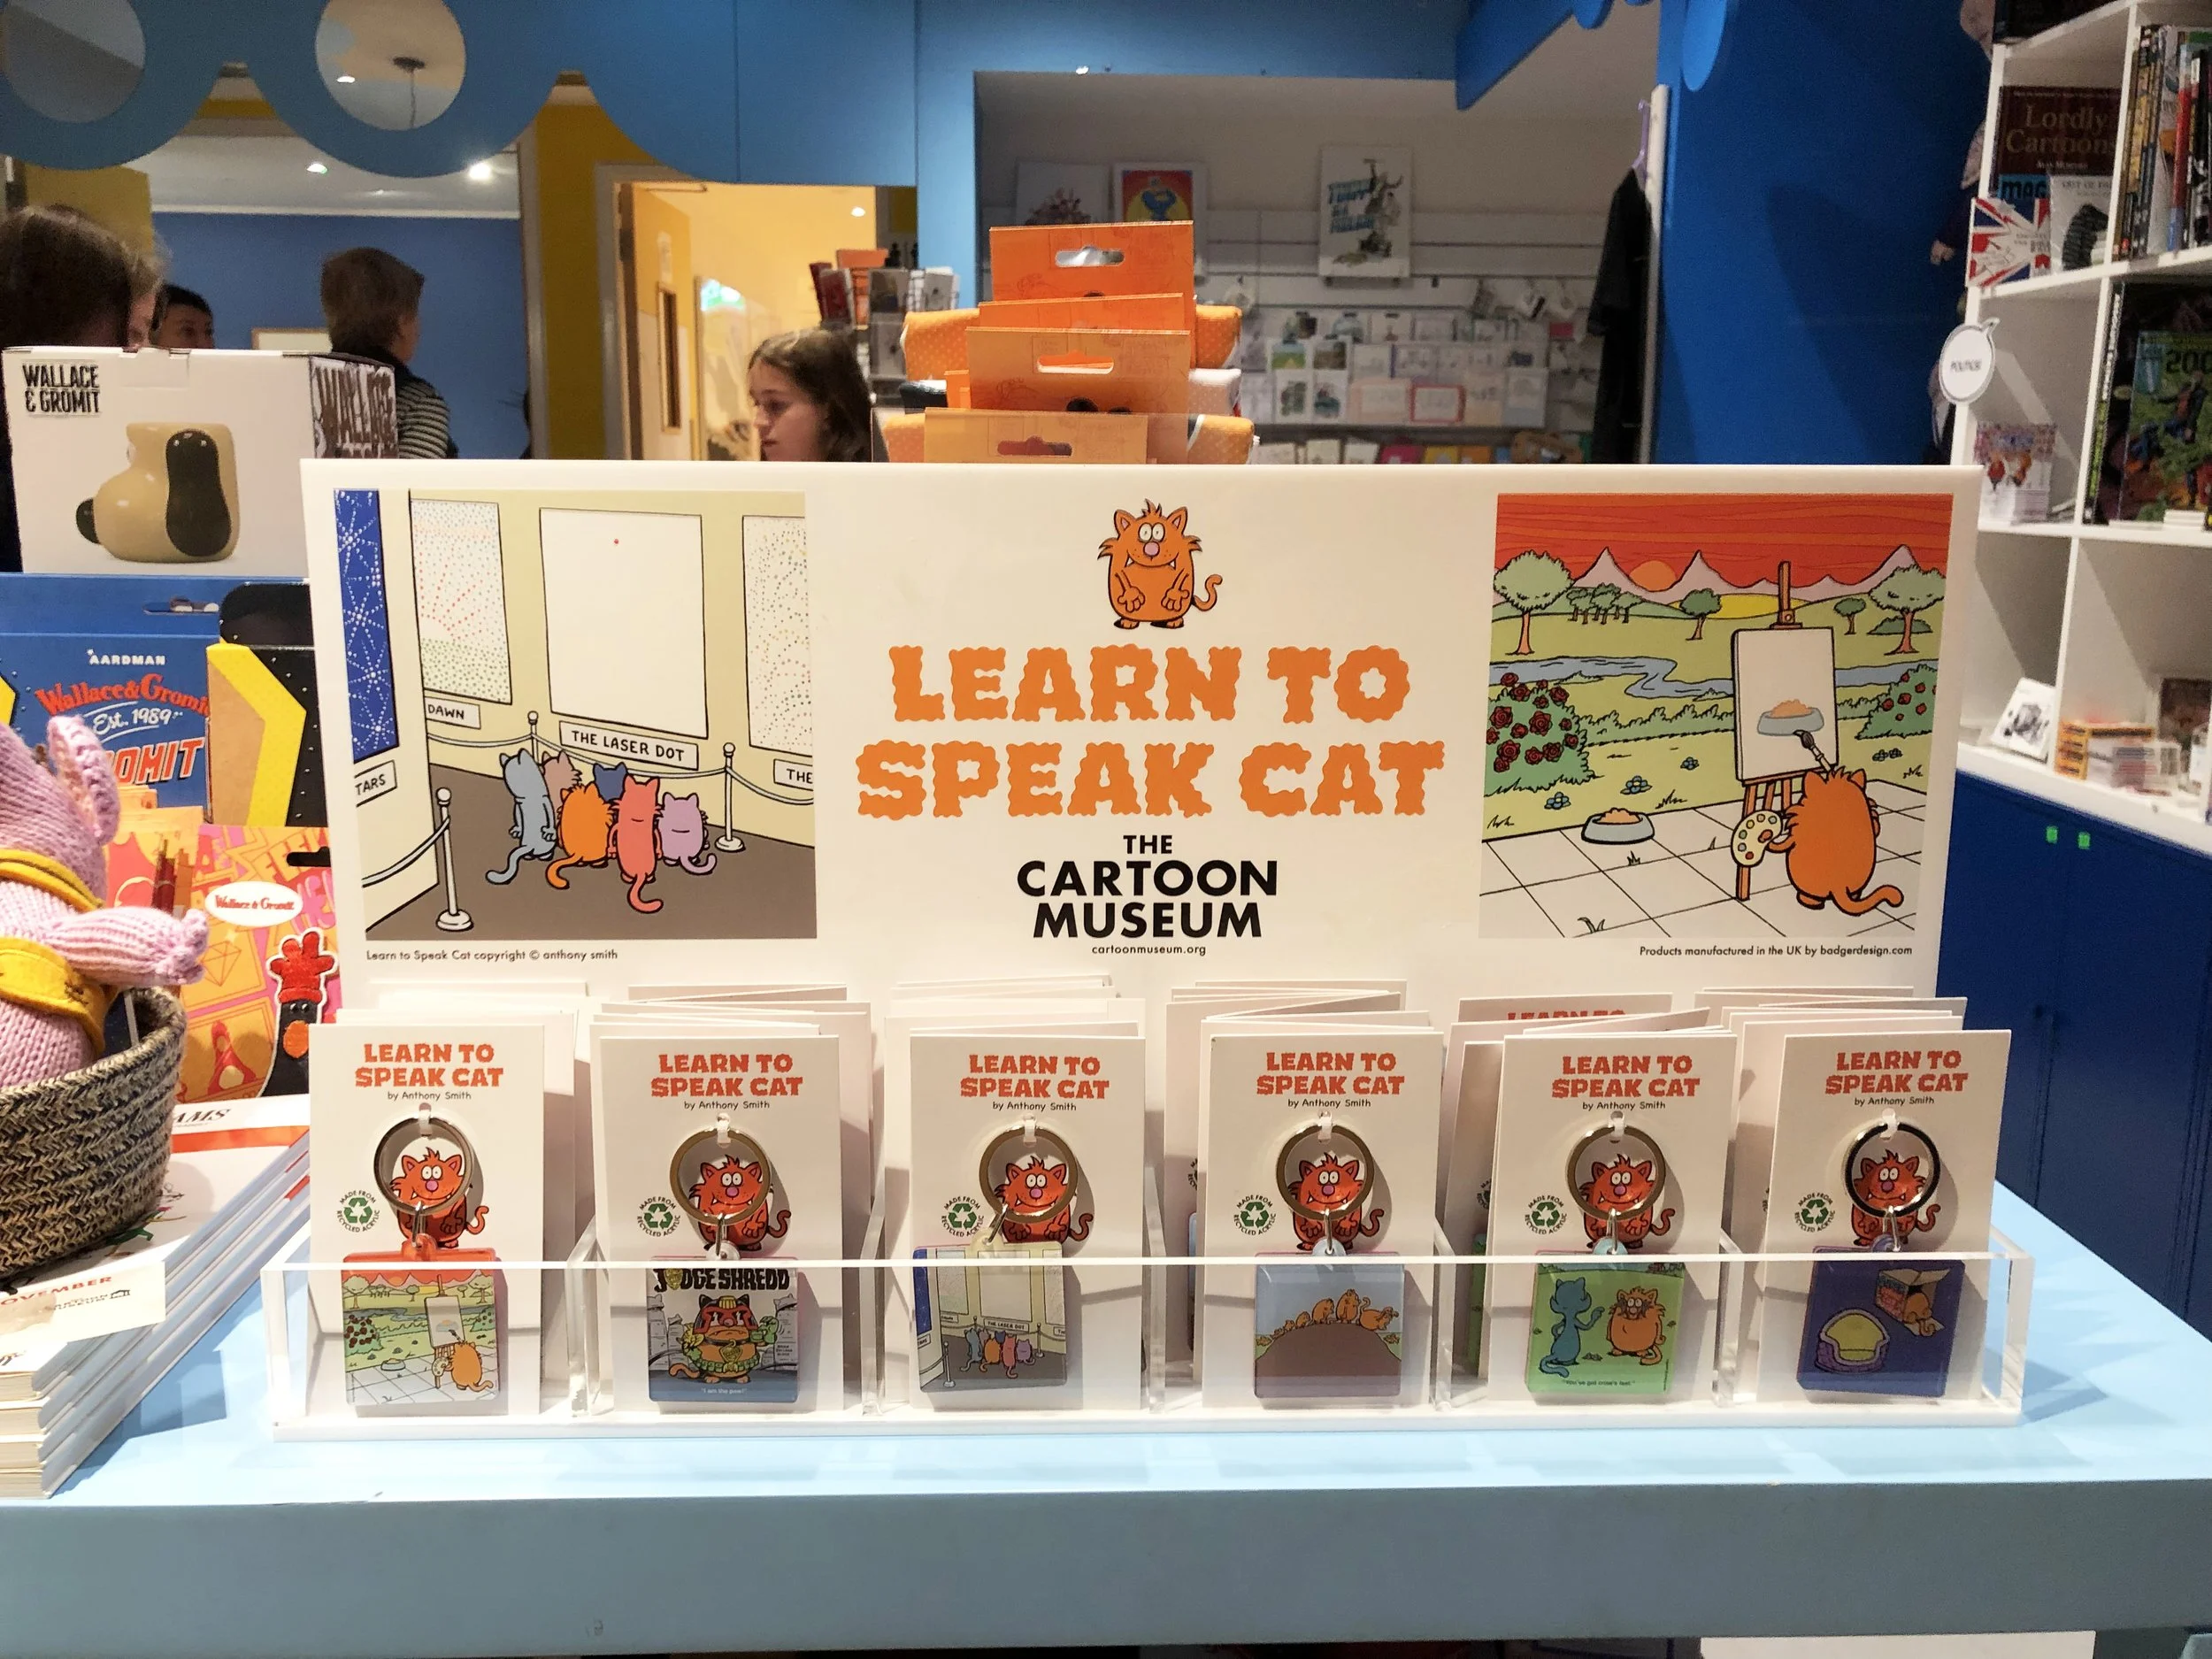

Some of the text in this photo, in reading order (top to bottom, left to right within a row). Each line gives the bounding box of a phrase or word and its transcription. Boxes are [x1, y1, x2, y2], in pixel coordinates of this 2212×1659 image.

[21, 364, 99, 388] WALLACE
[25, 389, 100, 413] & GROMIT
[88, 654, 166, 665] AARDMAN
[888, 644, 1410, 724] LEARN TO
[35, 682, 124, 716] Wallace
[92, 707, 172, 735] Est. 1989
[427, 704, 465, 721] DAWN
[571, 730, 685, 762] THE LASER DOT
[113, 737, 205, 785] OMIT
[355, 773, 387, 795] TARS
[786, 768, 813, 784] THE
[855, 739, 1445, 820] SPEAK CAT
[1123, 834, 1173, 855] THE
[1017, 860, 1278, 896] CARTOON
[1033, 902, 1262, 939] MUSEUM
[366, 949, 396, 961] Learn
[399, 950, 411, 961] to
[413, 949, 448, 964] Speak
[451, 949, 472, 961] Cat
[474, 949, 526, 964] copyright
[542, 949, 587, 964] anthony
[590, 949, 618, 961] smith
[1091, 944, 1206, 957] cartoonmuseum.org
[1640, 945, 1913, 958] Products manufactured in the UK by badgerdesign.com
[364, 1043, 495, 1064] LEARN TO
[658, 1053, 793, 1073] LEARN TO
[1266, 1052, 1397, 1071] LEARN TO
[1837, 1050, 1962, 1071] LEARN TO
[969, 1054, 1101, 1076] LEARN TO
[1563, 1055, 1693, 1075] LEARN TO
[355, 1067, 503, 1087] SPEAK CAT
[650, 1077, 803, 1097] SPEAK CAT
[1256, 1075, 1405, 1095] SPEAK CAT
[1824, 1072, 1969, 1094] SPEAK CAT
[388, 1091, 472, 1101] by Anthony Smith
[960, 1077, 1110, 1100] SPEAK CAT
[1551, 1078, 1701, 1098] SPEAK CAT
[684, 1101, 770, 1110] by Anthony Smith
[993, 1102, 1077, 1112] by Anthony Smith
[1287, 1099, 1299, 1109] by
[1302, 1099, 1341, 1109] Anthony
[1582, 1102, 1594, 1110] by
[1596, 1102, 1635, 1111] Anthony
[1855, 1097, 1865, 1106] by
[1867, 1096, 1905, 1106] Anthony
[340, 1190, 376, 1204] MADE FROM
[639, 1196, 676, 1210] MADE FROM
[943, 1196, 980, 1210] MADE FROM
[1236, 1194, 1273, 1209] MADE FROM
[1528, 1194, 1564, 1209] MADE FROM
[1798, 1192, 1833, 1207] MADE FROM
[336, 1209, 380, 1233] RECYCLED ACRYLIC
[637, 1214, 680, 1237] RECYCLED ACRYLIC
[941, 1214, 984, 1237] RECYCLED ACRYLIC
[1233, 1213, 1276, 1236] RECYCLED ACRYLIC
[1525, 1212, 1567, 1234] RECYCLED ACRYLIC
[1793, 1210, 1836, 1233] RECYCLED ACRYLIC
[653, 1268, 790, 1293] JDGE SHREDD
